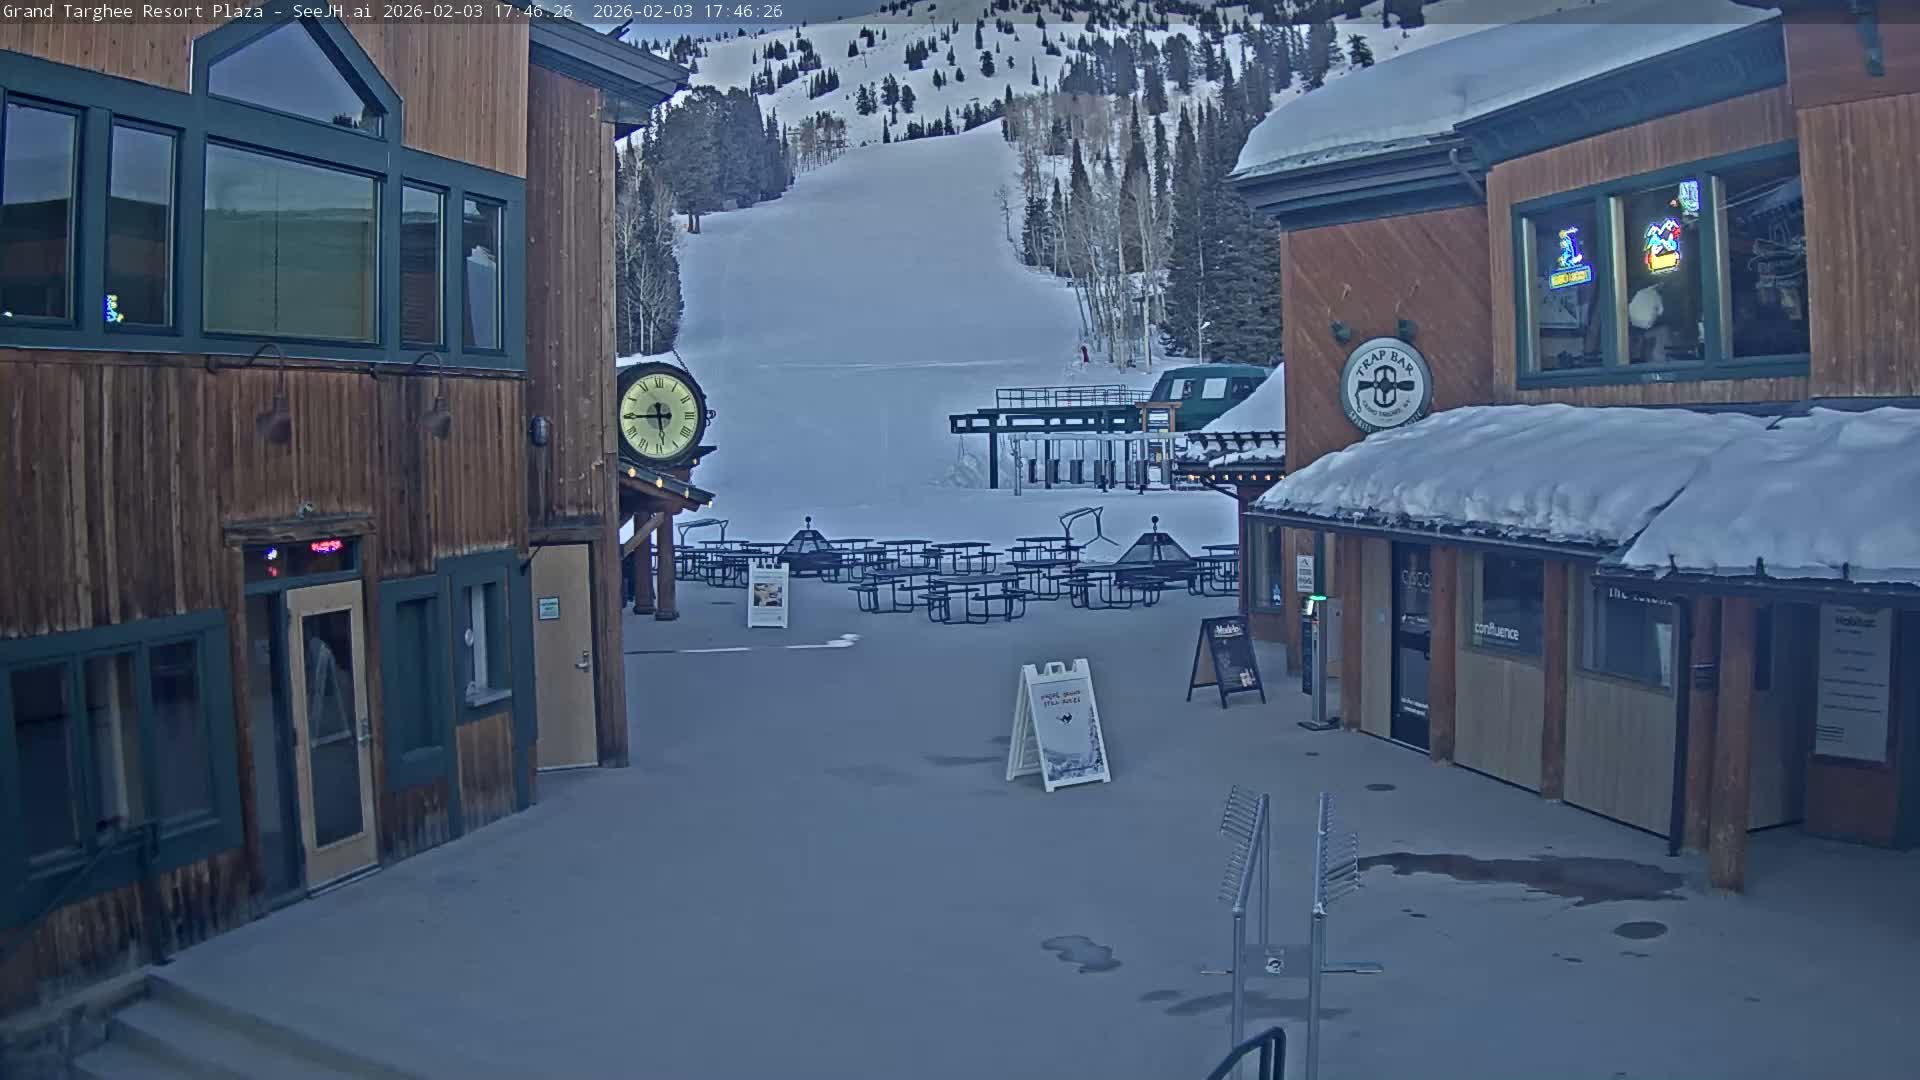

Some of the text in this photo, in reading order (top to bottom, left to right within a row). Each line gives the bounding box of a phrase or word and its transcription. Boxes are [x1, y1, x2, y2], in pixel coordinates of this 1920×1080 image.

[1356, 350, 1414, 377] TRAP BAR
[1474, 621, 1520, 641] confluence
